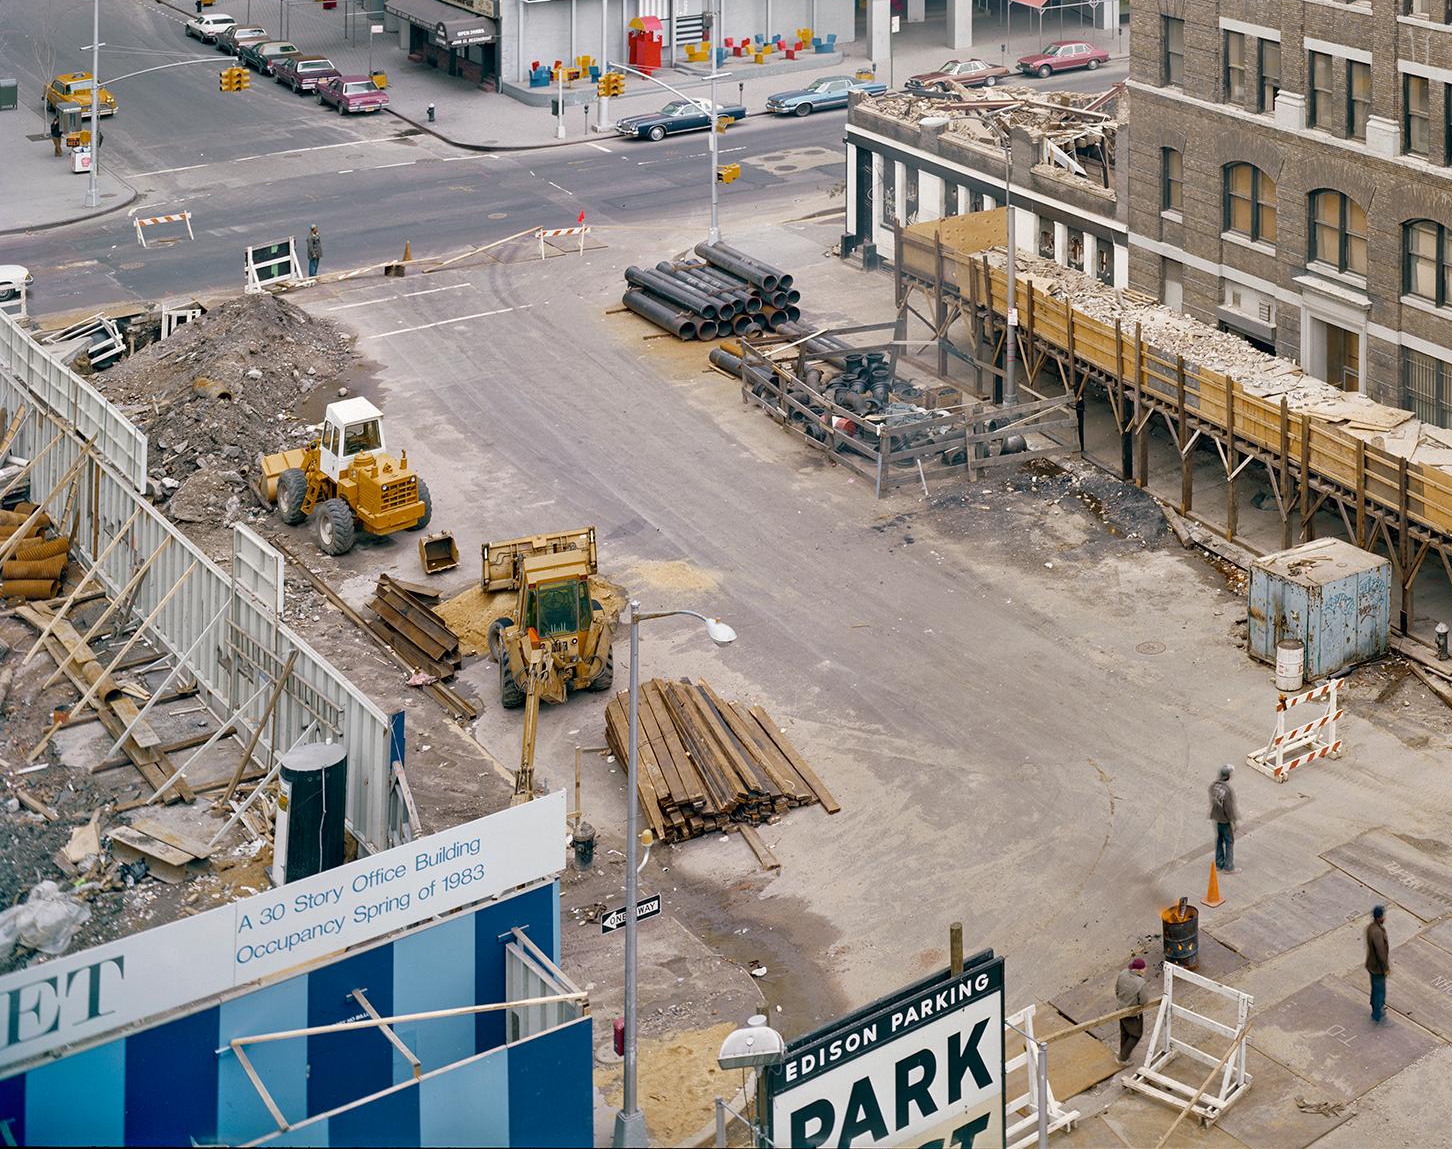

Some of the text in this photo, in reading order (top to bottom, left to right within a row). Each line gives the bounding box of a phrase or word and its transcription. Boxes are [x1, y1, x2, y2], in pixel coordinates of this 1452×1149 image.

[236, 863, 485, 964] Occupancy Spring of 1983
[238, 837, 481, 933] A 30 Story Office Building
[610, 902, 656, 925] ONE WAY
[785, 973, 990, 1083] EDISON PARKING
[790, 1016, 994, 1149] PARK
